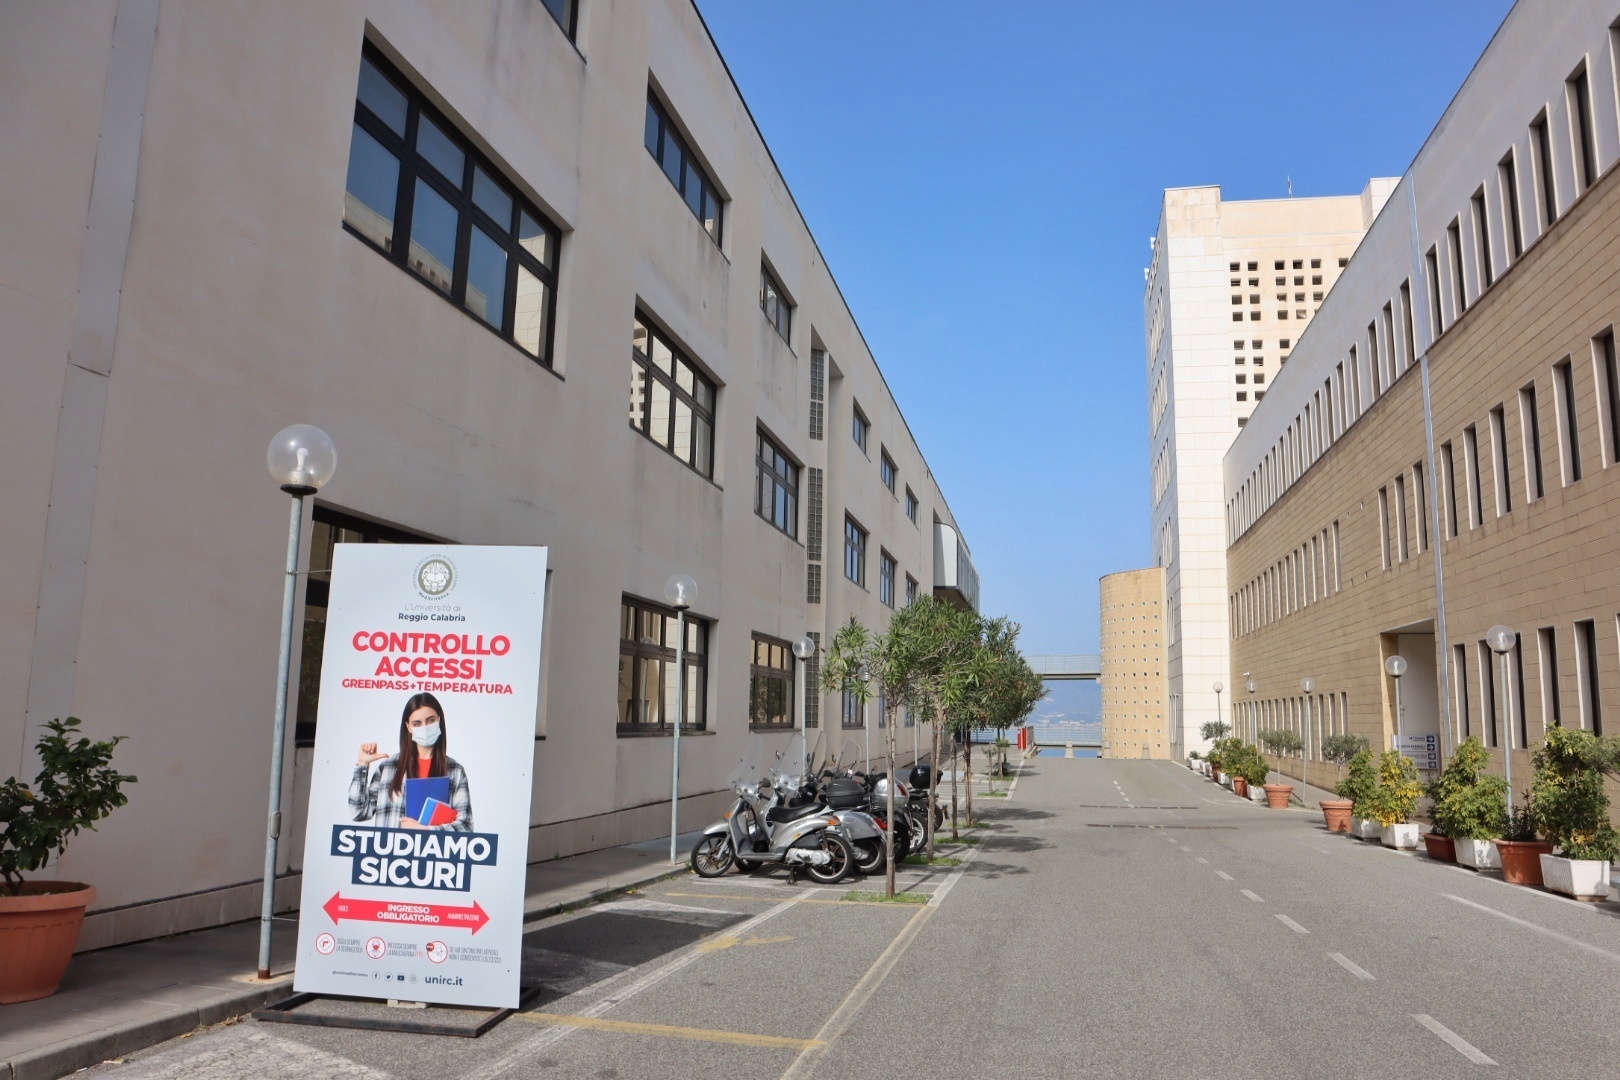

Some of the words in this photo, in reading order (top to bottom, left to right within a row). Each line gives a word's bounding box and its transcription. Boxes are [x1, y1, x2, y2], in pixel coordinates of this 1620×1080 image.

[452, 604, 461, 612] di
[398, 613, 429, 622] Reggio
[431, 613, 466, 622] Calabria
[352, 631, 511, 656] CONTROLLO
[374, 656, 483, 680] ACCESSI
[341, 678, 513, 695] GREENPASS+TEMPERATURA
[337, 829, 491, 862] STUDIAMO
[358, 856, 465, 889] SICURI
[387, 903, 430, 914] INGRESSO
[377, 911, 440, 923] OBBLIGATORIO
[424, 975, 463, 986] unirc.it
